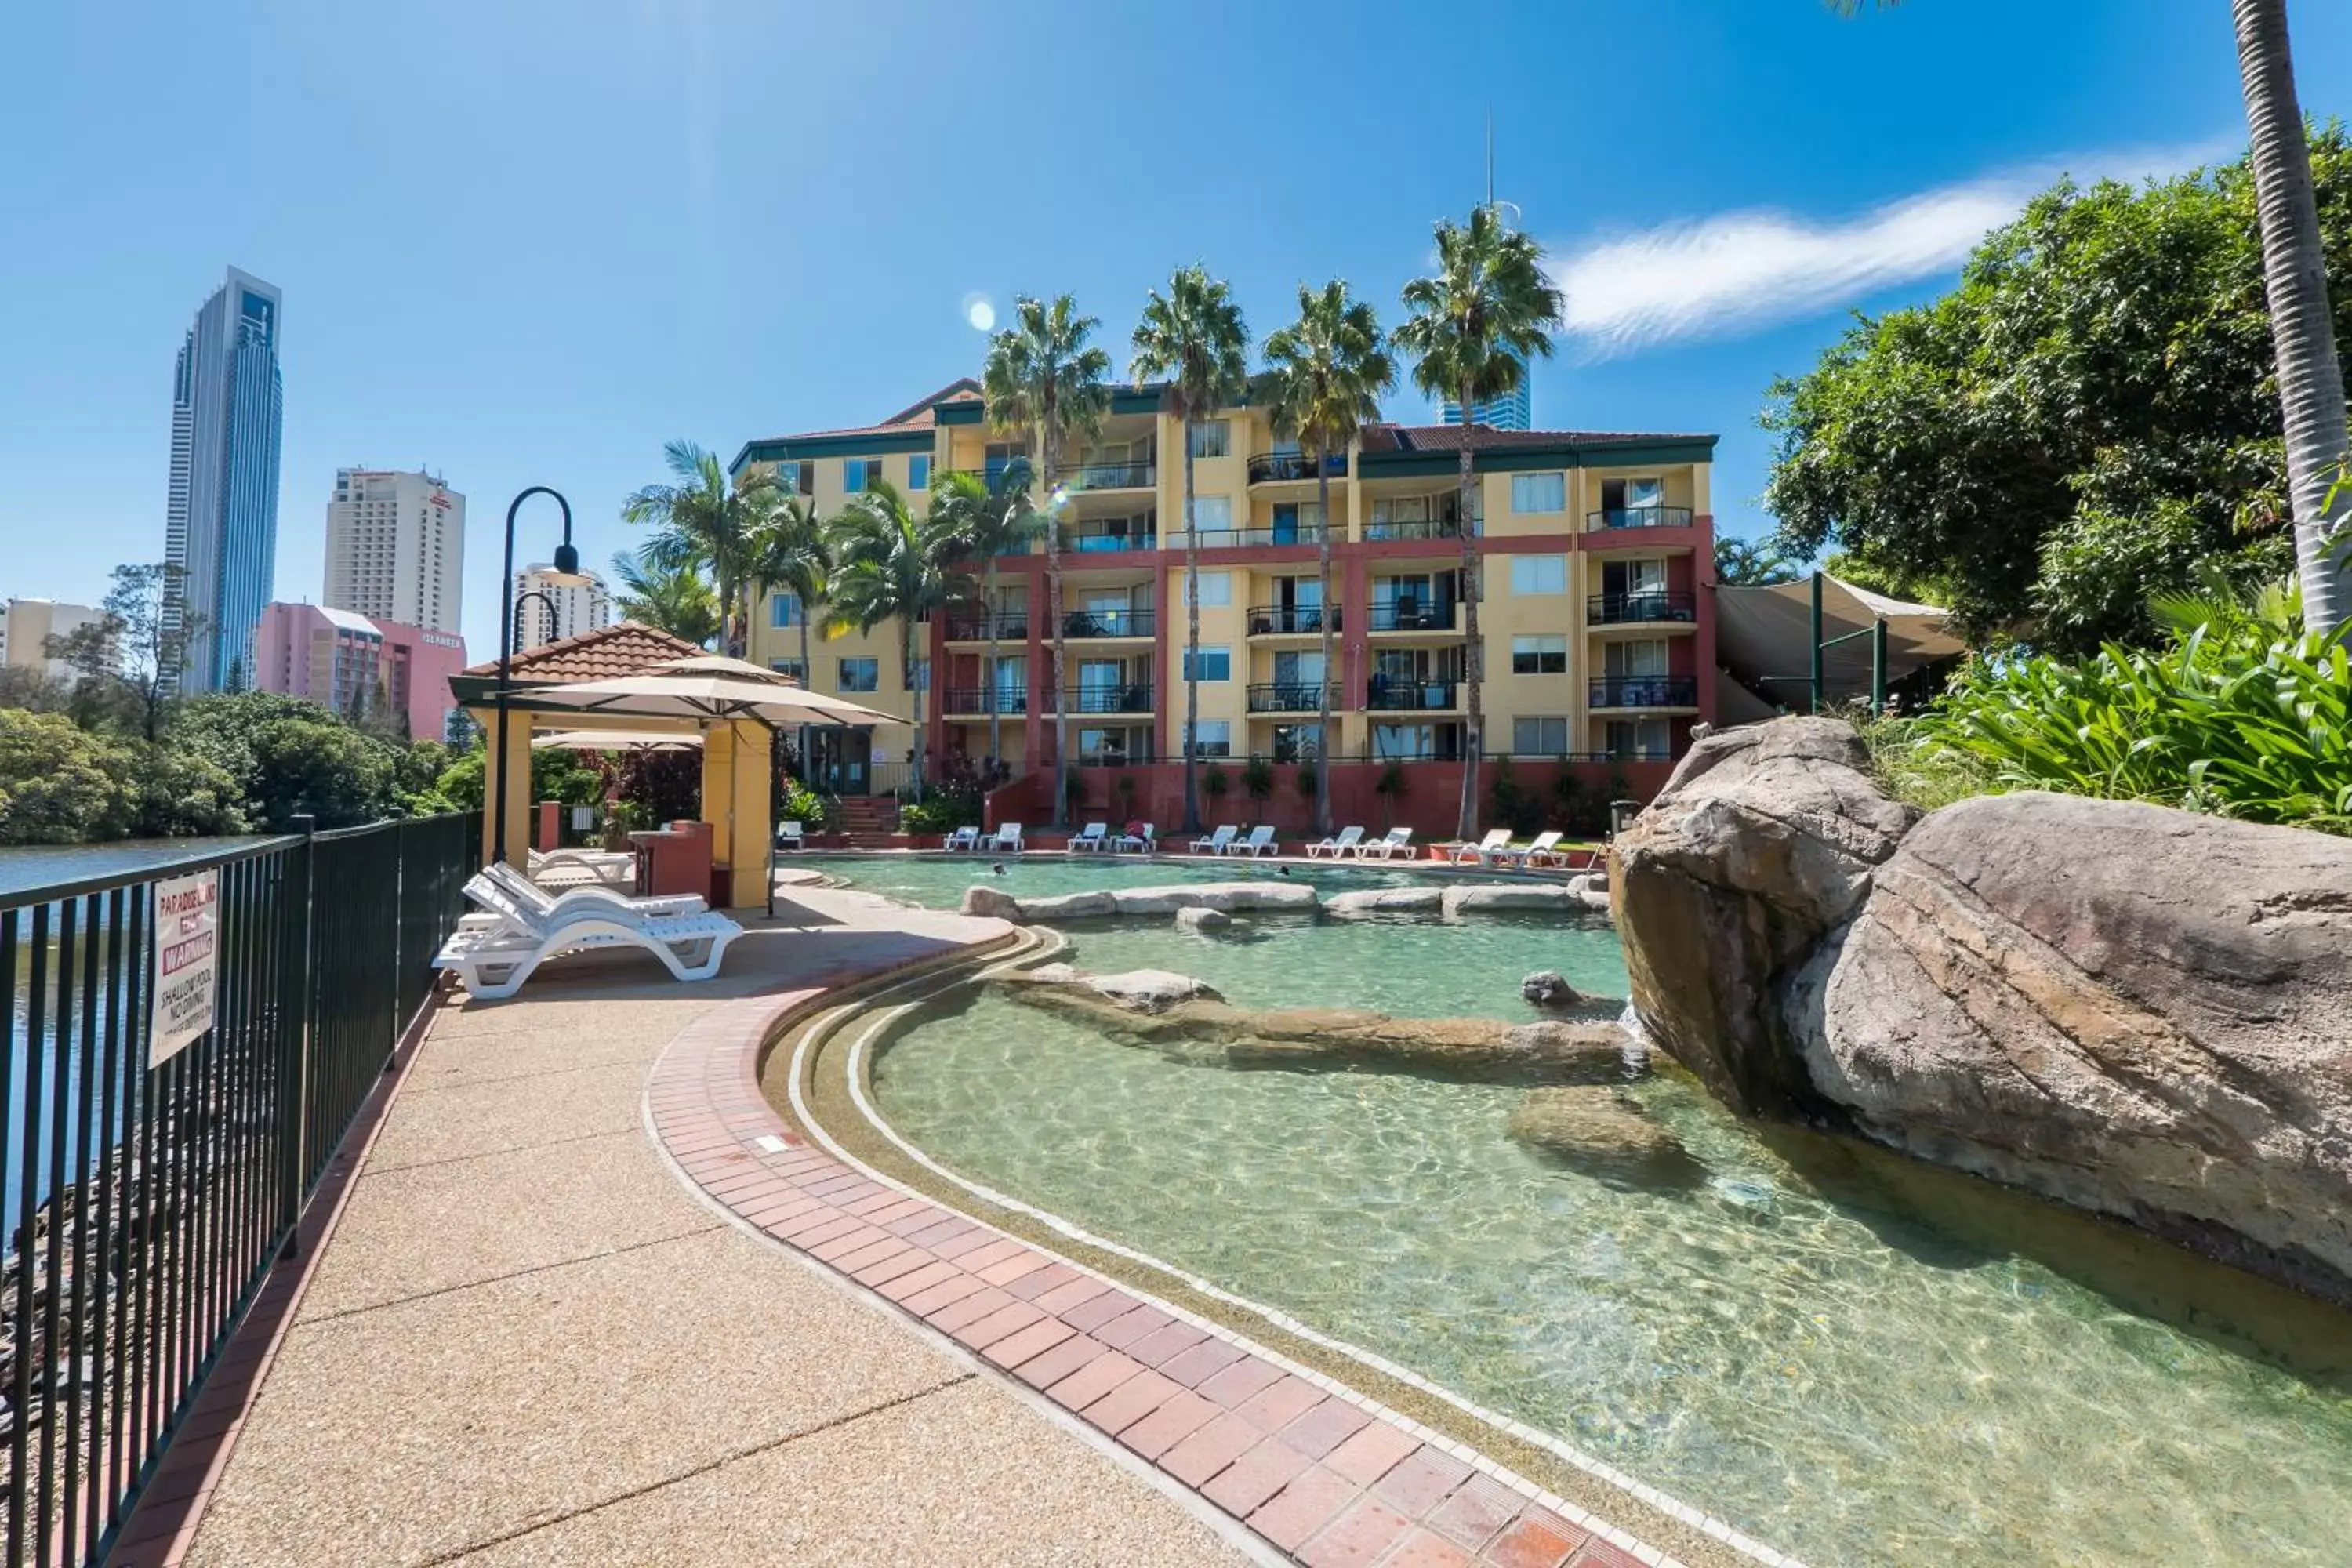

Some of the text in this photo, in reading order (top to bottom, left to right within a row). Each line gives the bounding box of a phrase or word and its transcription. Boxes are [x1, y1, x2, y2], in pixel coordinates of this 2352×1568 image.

[423, 633, 460, 648] ISLANDER
[160, 889, 198, 918] PARADISE
[165, 932, 212, 971] WARNING
[161, 968, 211, 1010] SHALLOW POOL
[170, 1002, 182, 1022] NO
[183, 987, 205, 1015] DIVING
